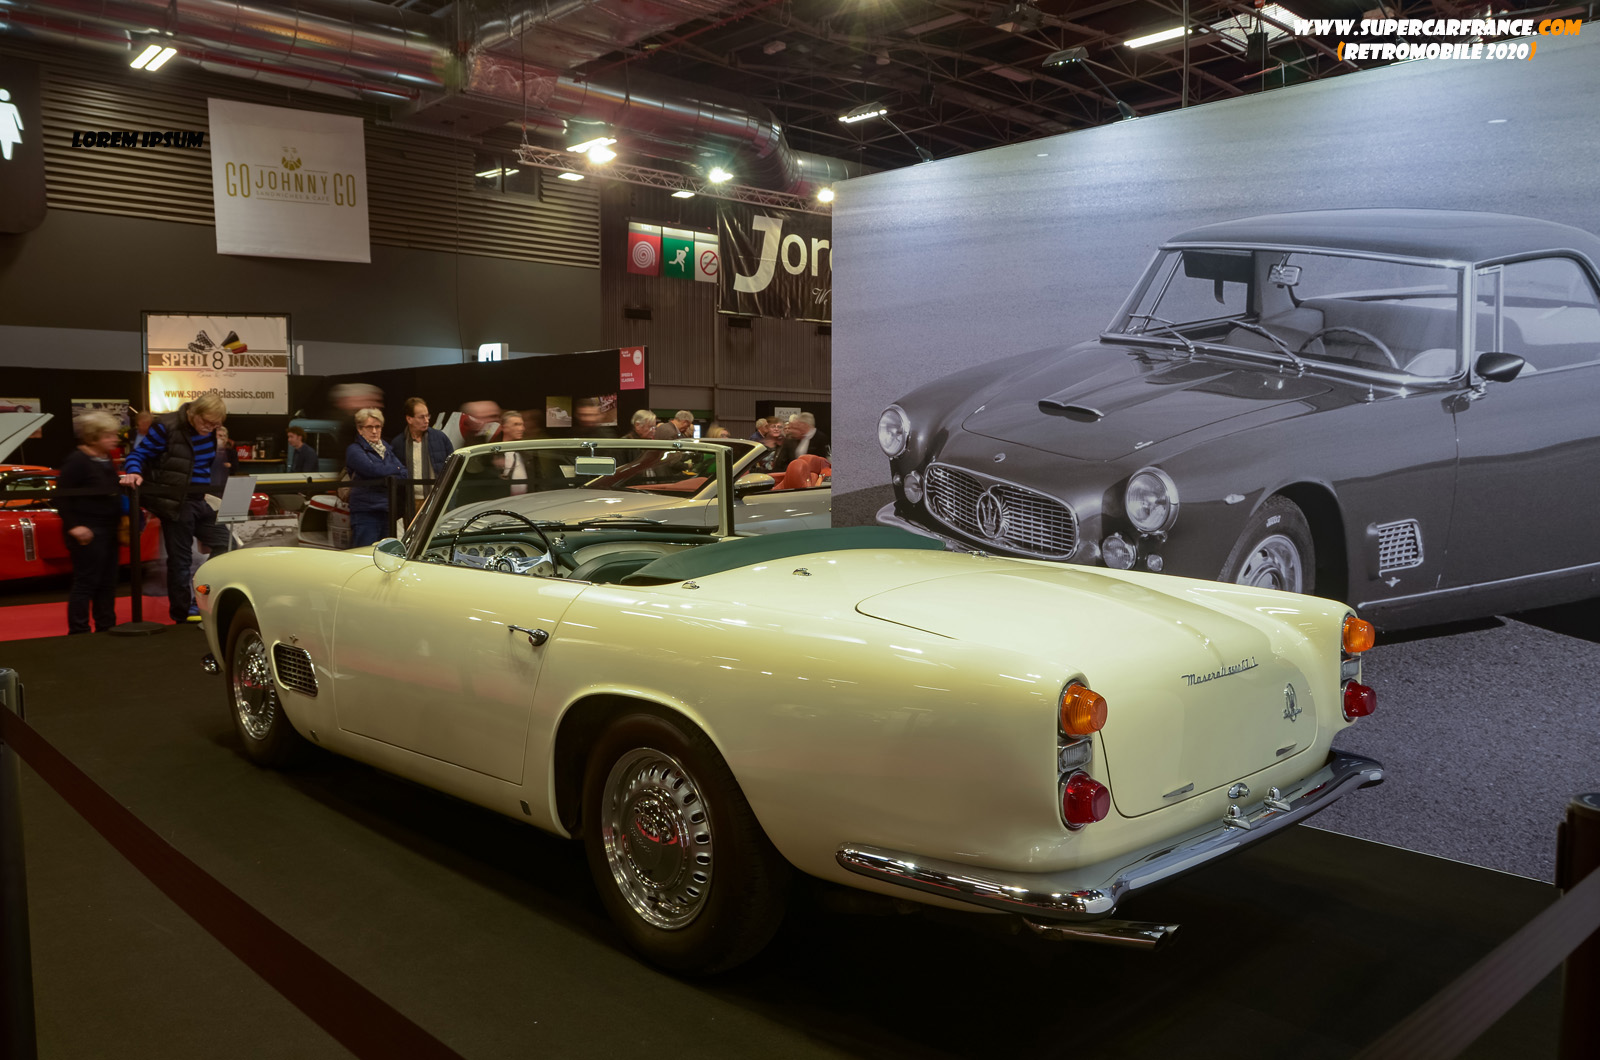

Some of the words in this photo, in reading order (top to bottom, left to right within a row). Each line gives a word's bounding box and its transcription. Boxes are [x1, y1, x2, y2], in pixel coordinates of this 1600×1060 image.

[225, 161, 251, 198] GO
[255, 169, 328, 195] JOHNNY
[333, 172, 356, 207] GO
[733, 214, 832, 294] Jor
[162, 353, 204, 367] SPEED
[212, 350, 224, 370] 8
[232, 354, 275, 368] CLASSICS
[1181, 666, 1226, 686] Maserati
